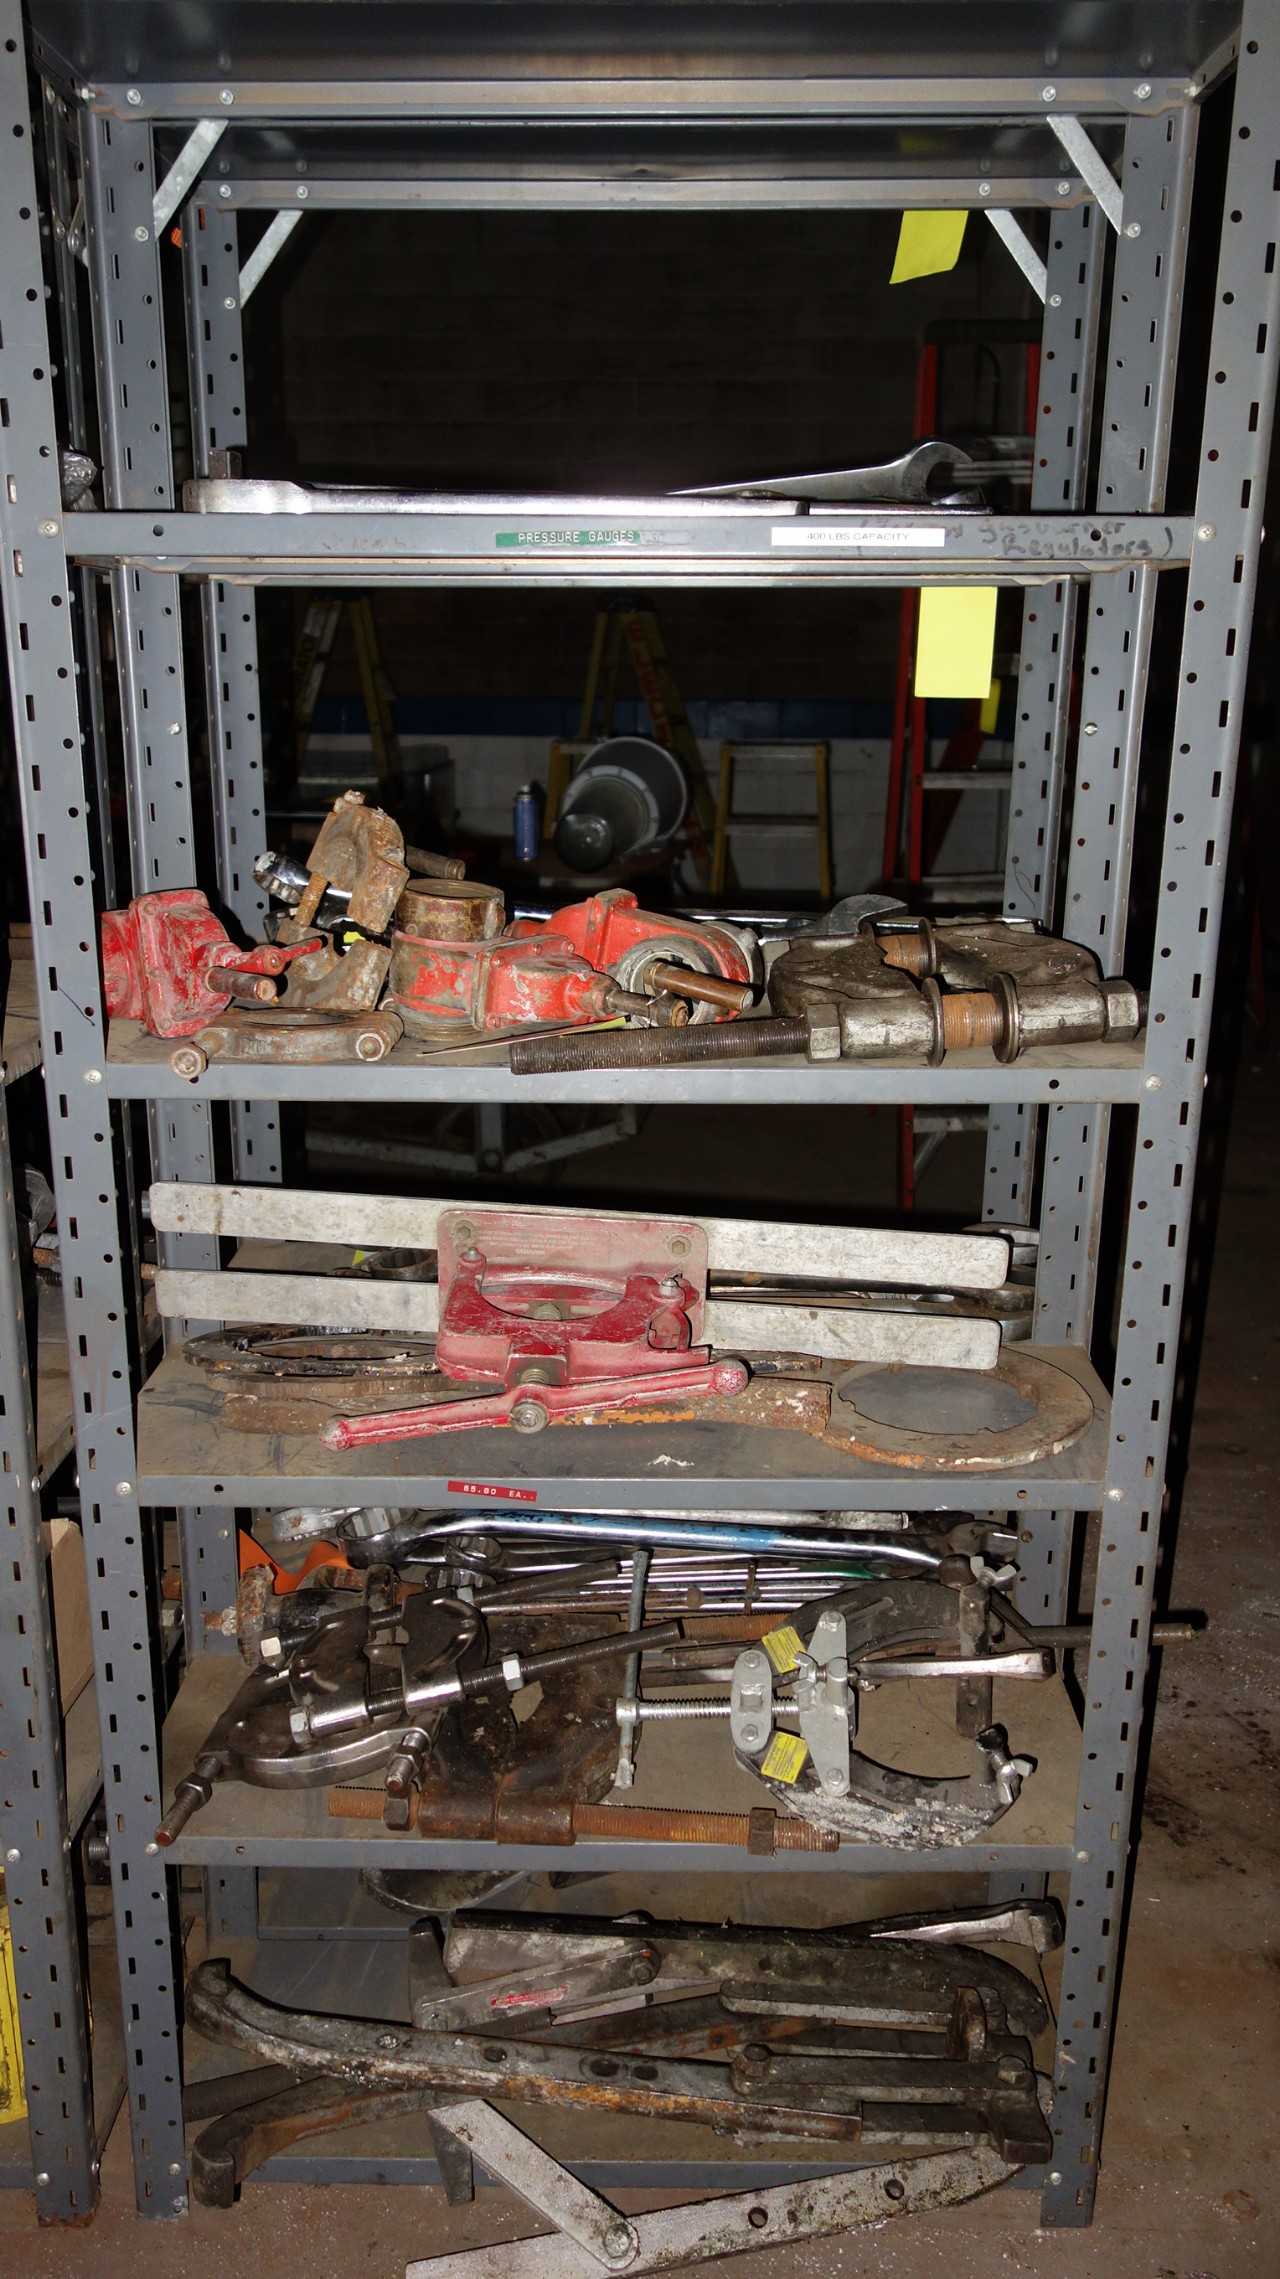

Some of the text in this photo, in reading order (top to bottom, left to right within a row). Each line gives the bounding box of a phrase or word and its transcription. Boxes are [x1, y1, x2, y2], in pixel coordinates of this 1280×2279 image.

[518, 530, 635, 543] PRESSURE GAUGES
[807, 532, 911, 541] 400 LBS CAPACITY
